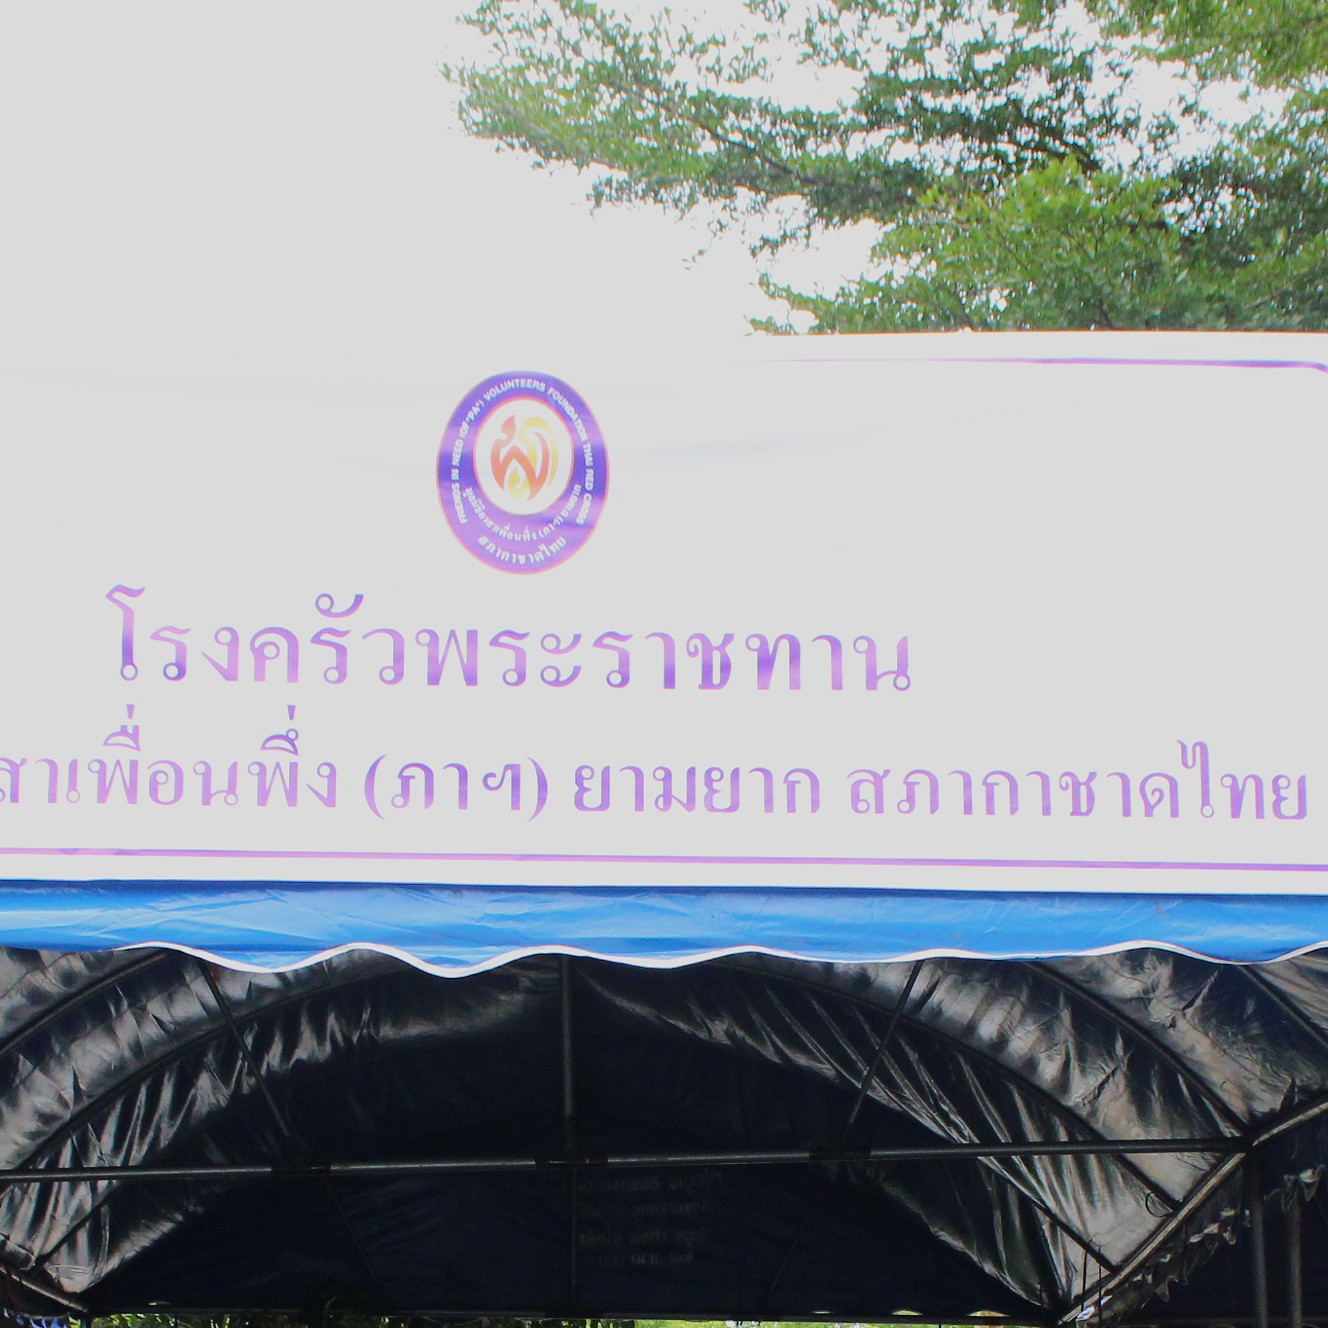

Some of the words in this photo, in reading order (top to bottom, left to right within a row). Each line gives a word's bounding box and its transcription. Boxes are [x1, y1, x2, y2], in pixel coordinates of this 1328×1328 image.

[483, 378, 547, 402] VOLUNTEERS
[547, 386, 589, 443] FOUNDATION
[451, 438, 465, 467] NEED
[582, 442, 594, 467] THAI
[450, 468, 460, 480] IN
[584, 468, 595, 491] RED
[451, 482, 468, 525] FRIENDS
[575, 493, 593, 526] CROSS
[477, 534, 568, 566] สภากาชาดไทย
[106, 584, 911, 692] โรงครัวพระราชทาน
[363, 754, 549, 821] (ภาฯ)
[574, 764, 822, 815] ยามยาก
[847, 739, 1308, 821] สภากาชาดไทย
